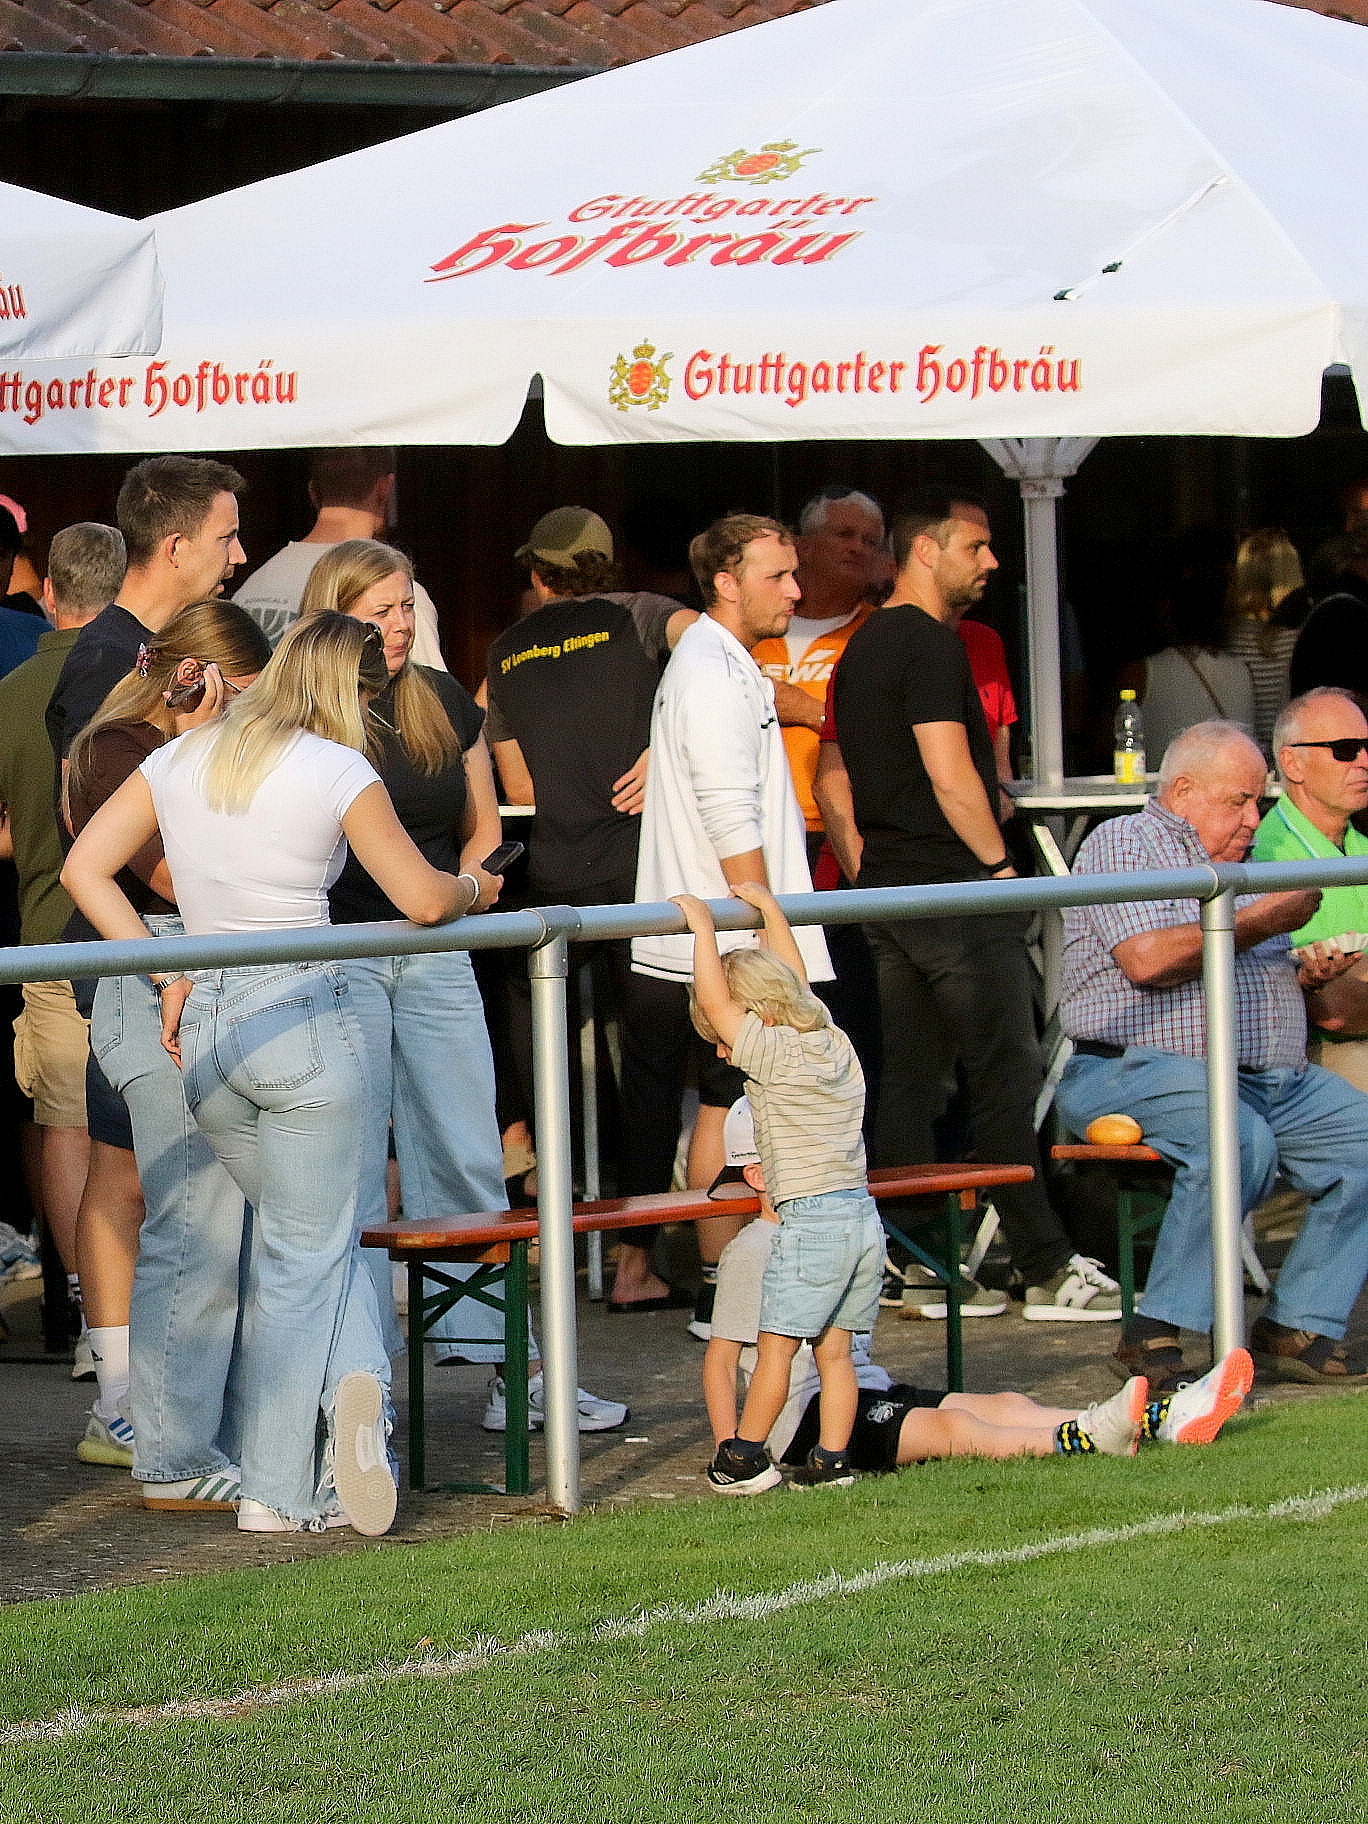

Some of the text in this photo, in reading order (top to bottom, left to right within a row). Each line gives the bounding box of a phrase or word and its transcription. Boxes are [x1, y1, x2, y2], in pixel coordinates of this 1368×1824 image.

[567, 191, 877, 224] Stuttgarter
[423, 217, 865, 282] Hofbräu
[144, 359, 299, 418] Hofbräu
[683, 344, 1083, 408] Stuttgarter Hofbräu
